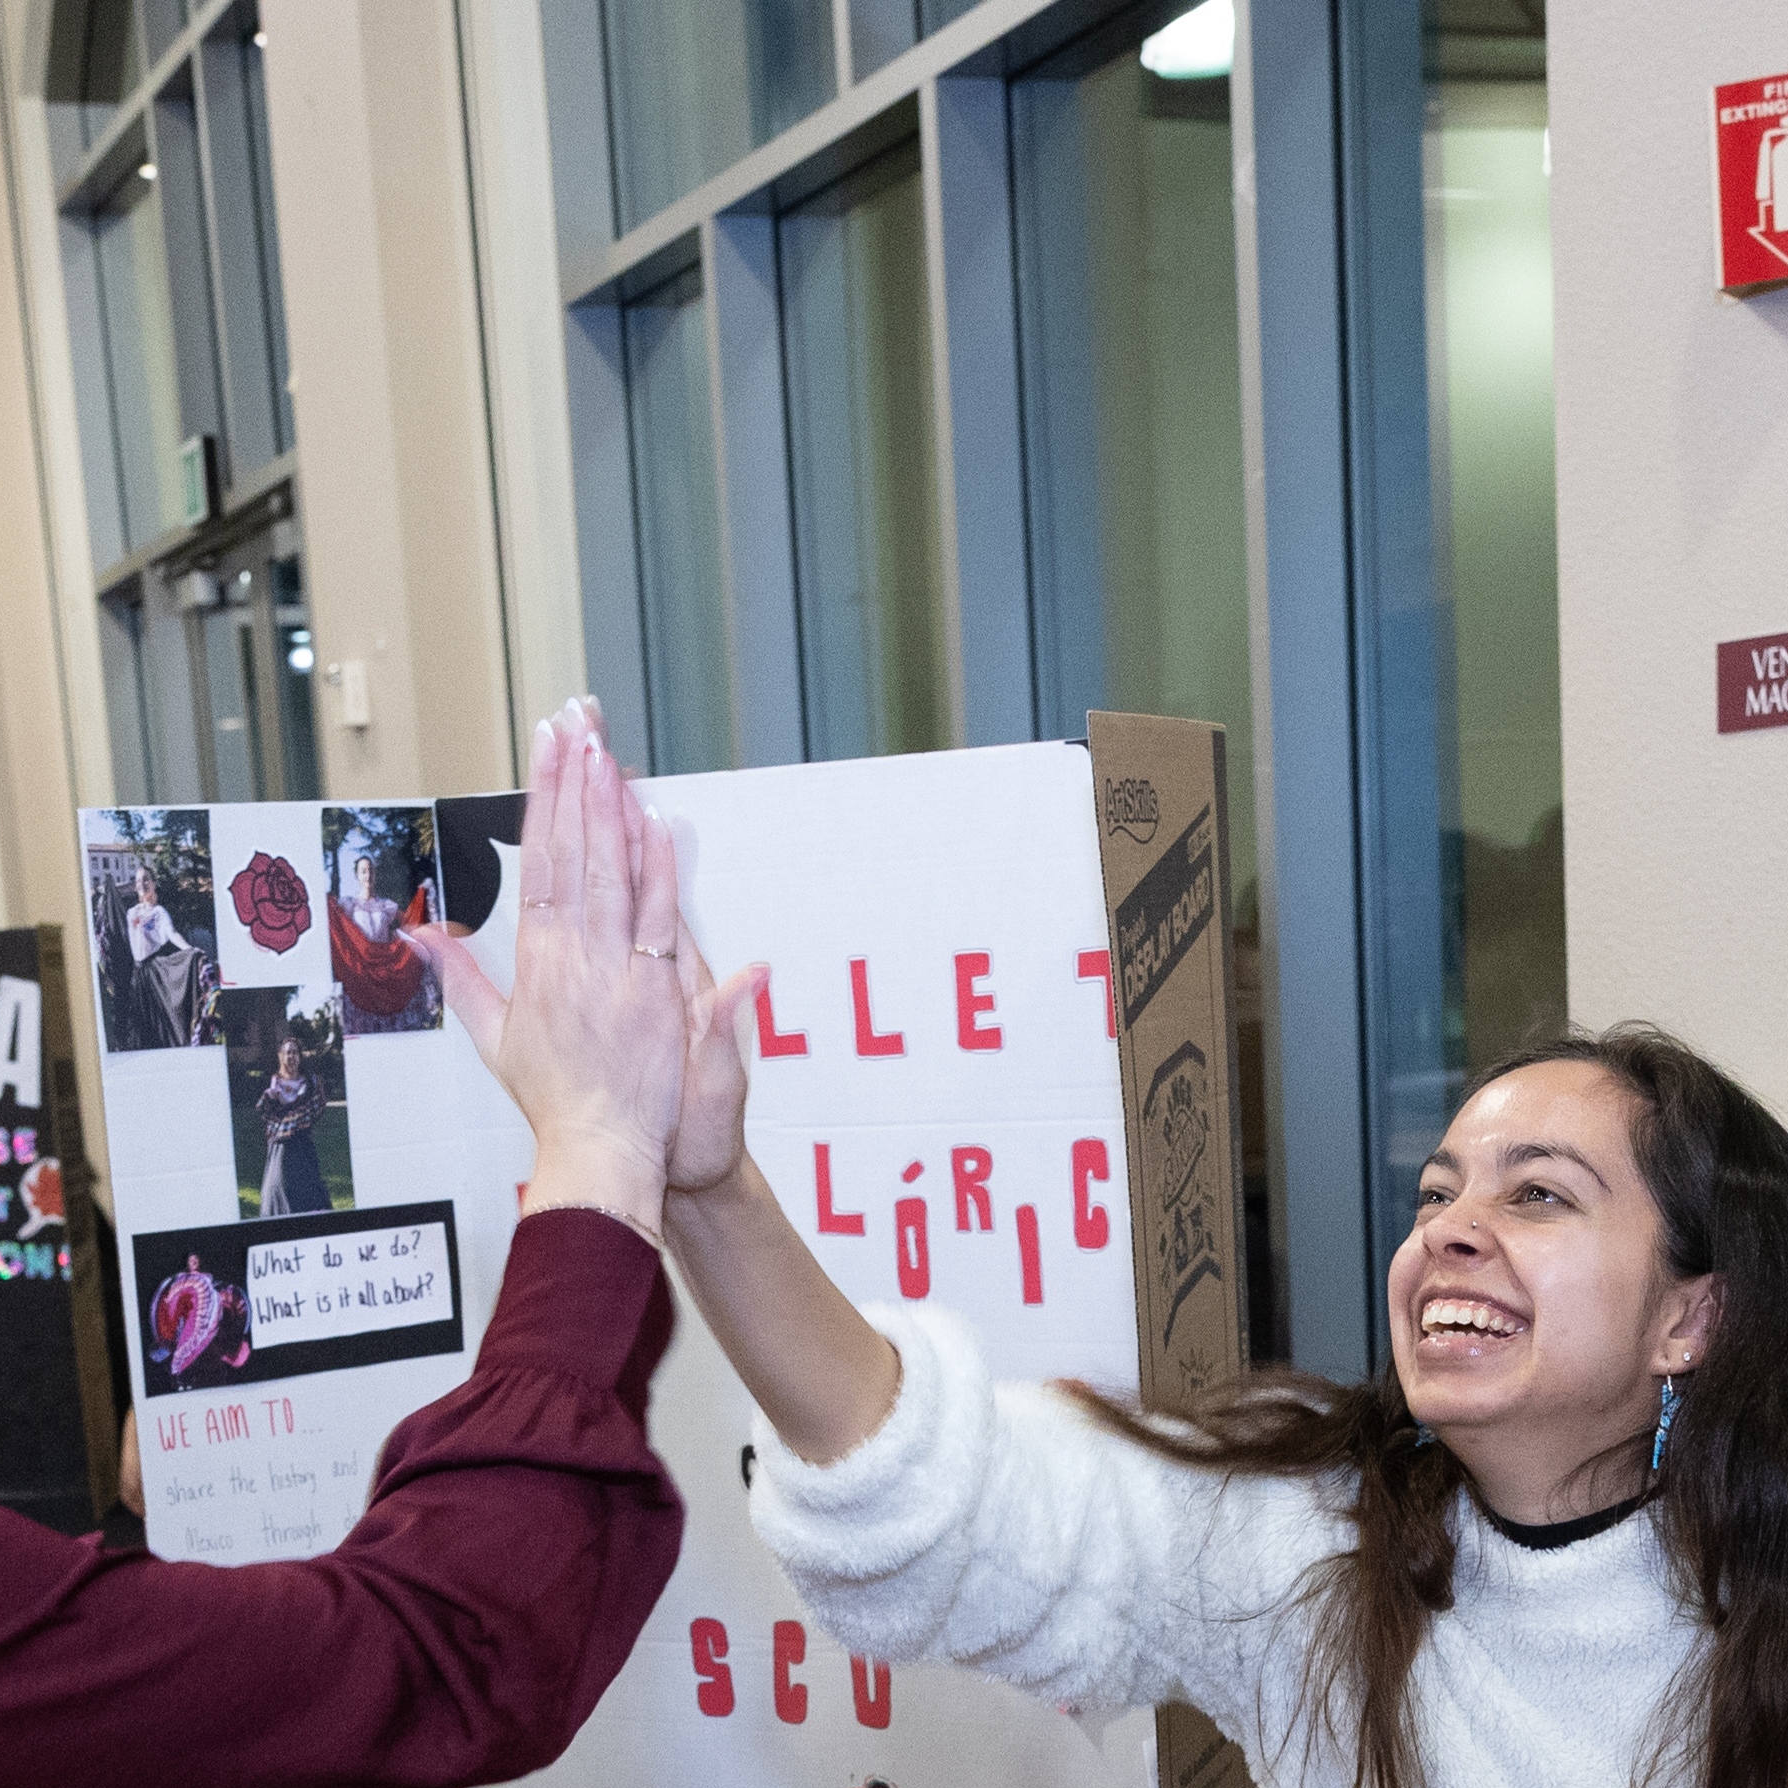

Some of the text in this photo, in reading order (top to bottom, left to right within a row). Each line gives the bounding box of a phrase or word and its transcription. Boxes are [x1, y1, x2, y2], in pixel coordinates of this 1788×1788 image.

[1125, 911, 1172, 1008] DISPLAY
[1171, 866, 1211, 946] BOARD
[252, 1230, 423, 1279] What do we do?
[256, 1272, 436, 1325] What is it all about?
[157, 1412, 191, 1452] WE
[205, 1404, 250, 1445] AIM
[230, 1465, 258, 1494] the
[689, 1617, 892, 1730] SCU
